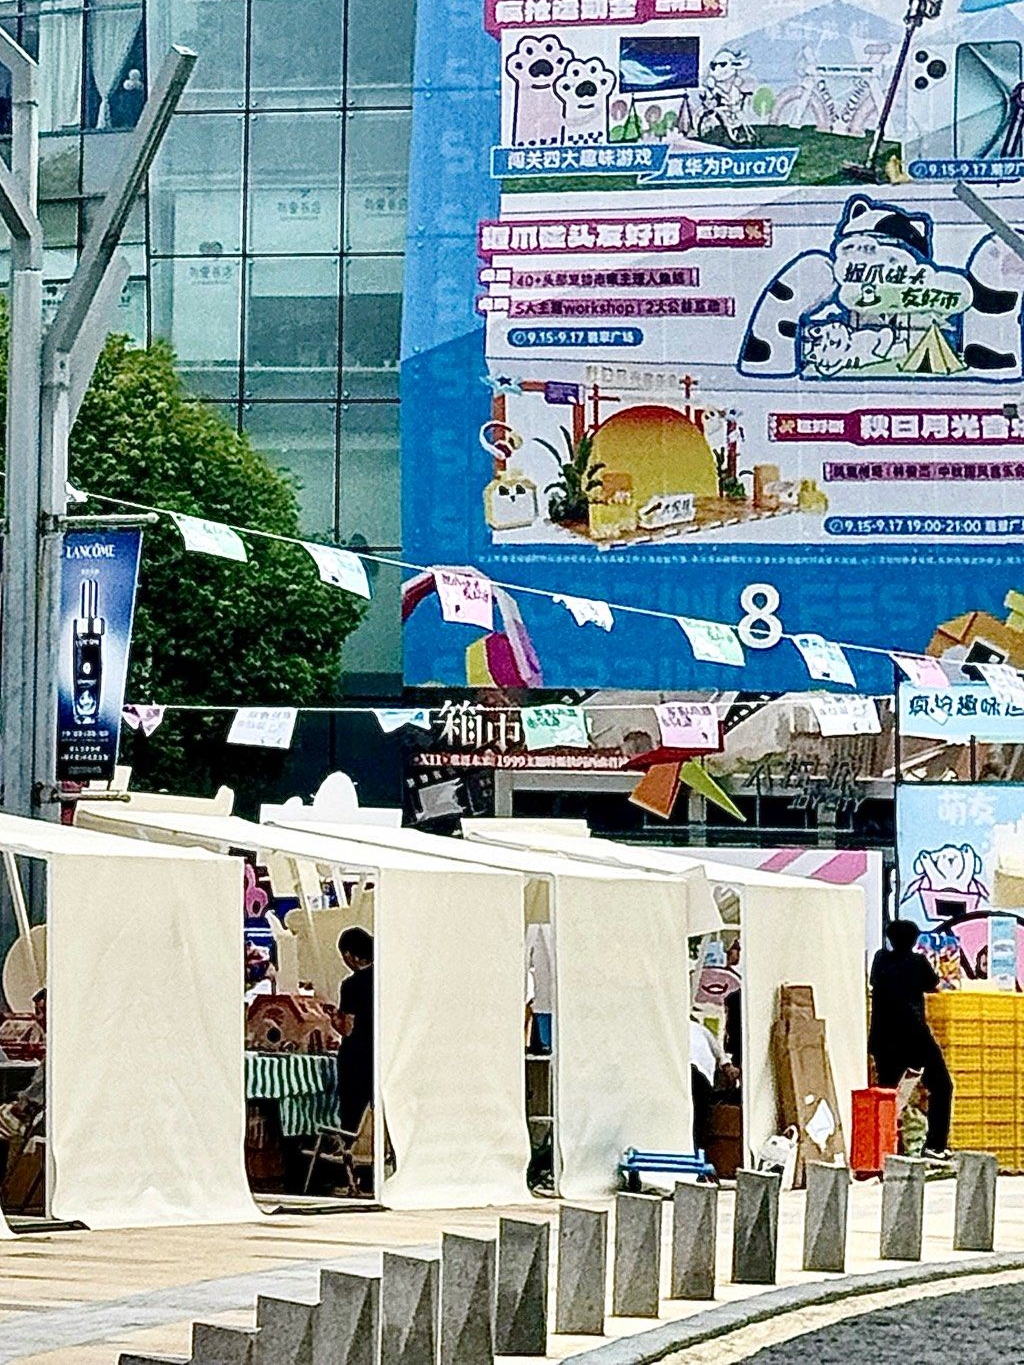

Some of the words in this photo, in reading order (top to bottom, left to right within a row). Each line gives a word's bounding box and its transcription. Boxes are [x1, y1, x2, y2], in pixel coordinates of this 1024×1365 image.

[507, 149, 653, 171] 闯关四大趣味游戏
[66, 542, 115, 558] LANCÔME
[738, 583, 783, 650] 8
